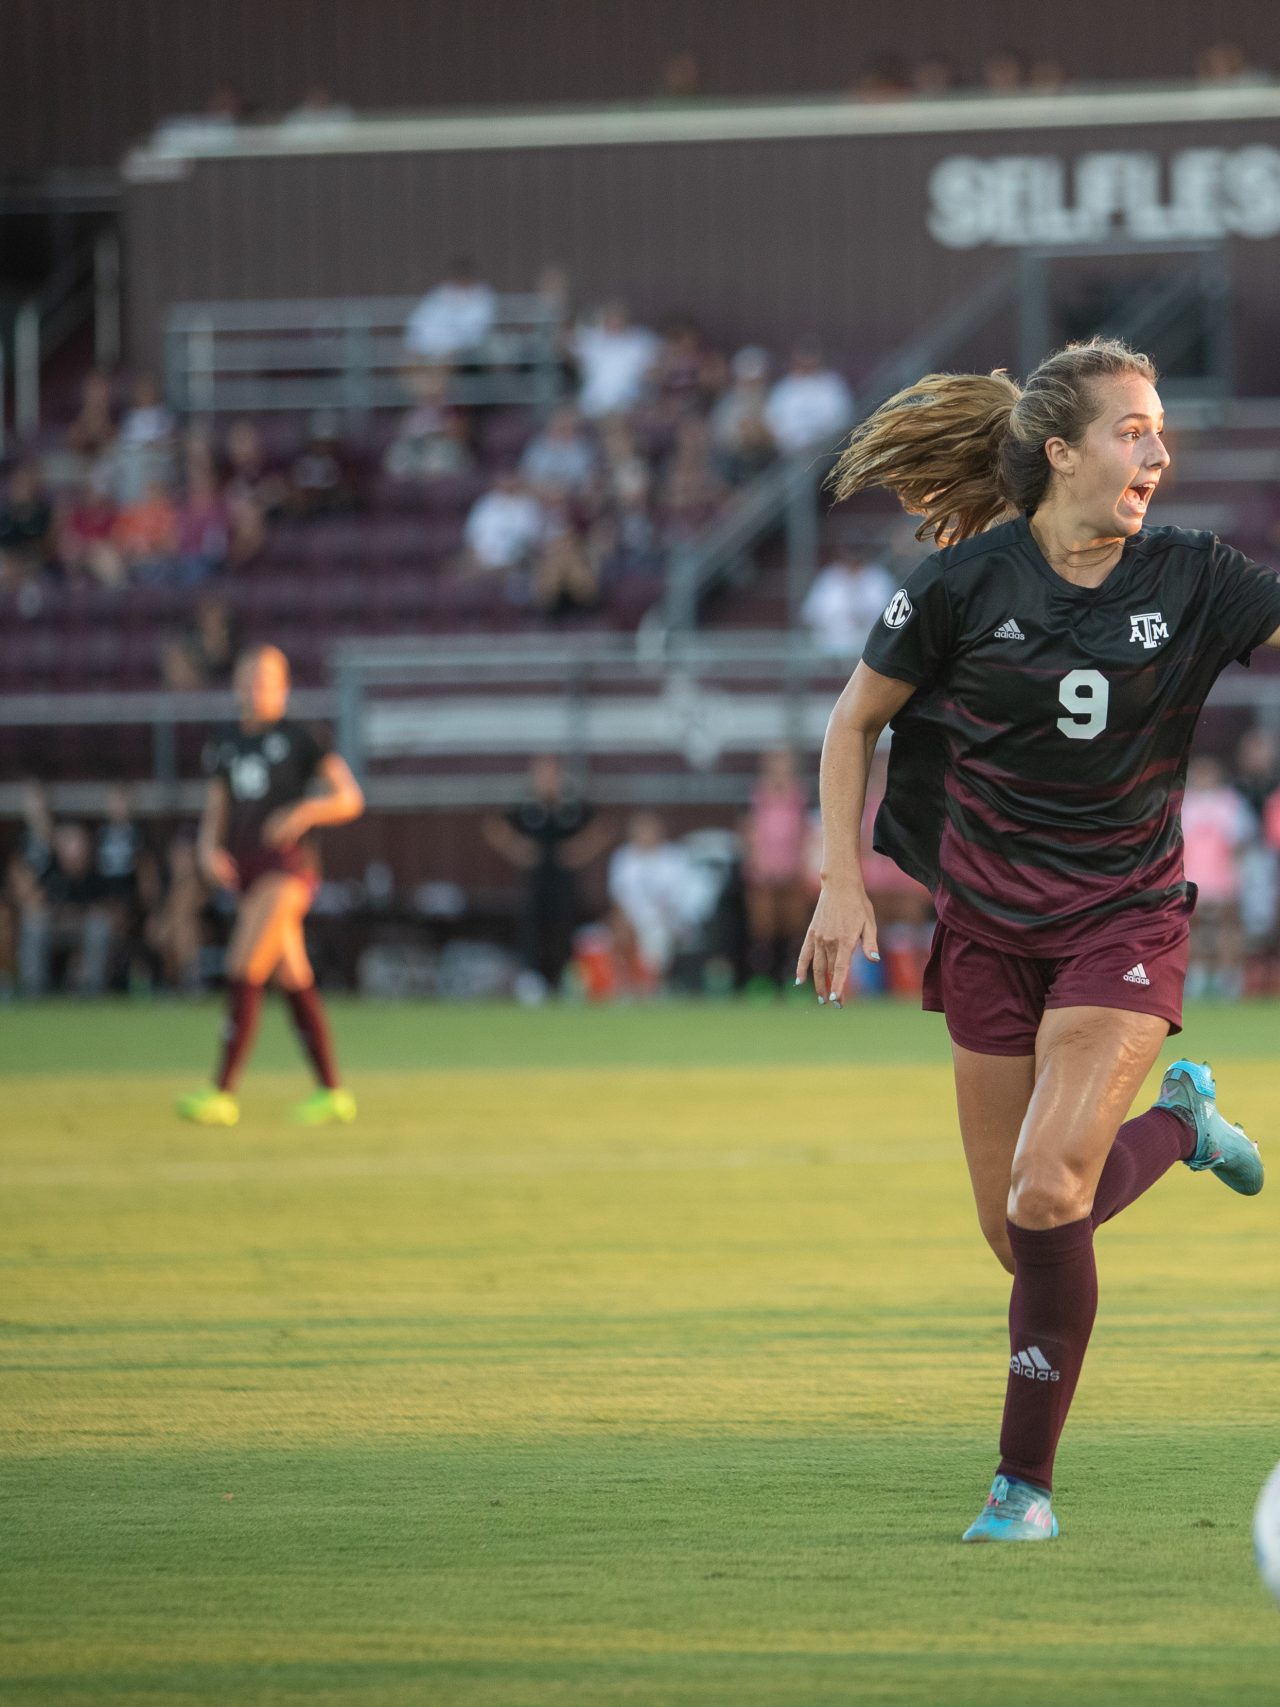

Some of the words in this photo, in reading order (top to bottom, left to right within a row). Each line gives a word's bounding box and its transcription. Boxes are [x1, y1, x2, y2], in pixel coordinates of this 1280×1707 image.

[994, 631, 1025, 640] adidas
[1057, 669, 1109, 739] 9
[1123, 974, 1150, 986] adidas
